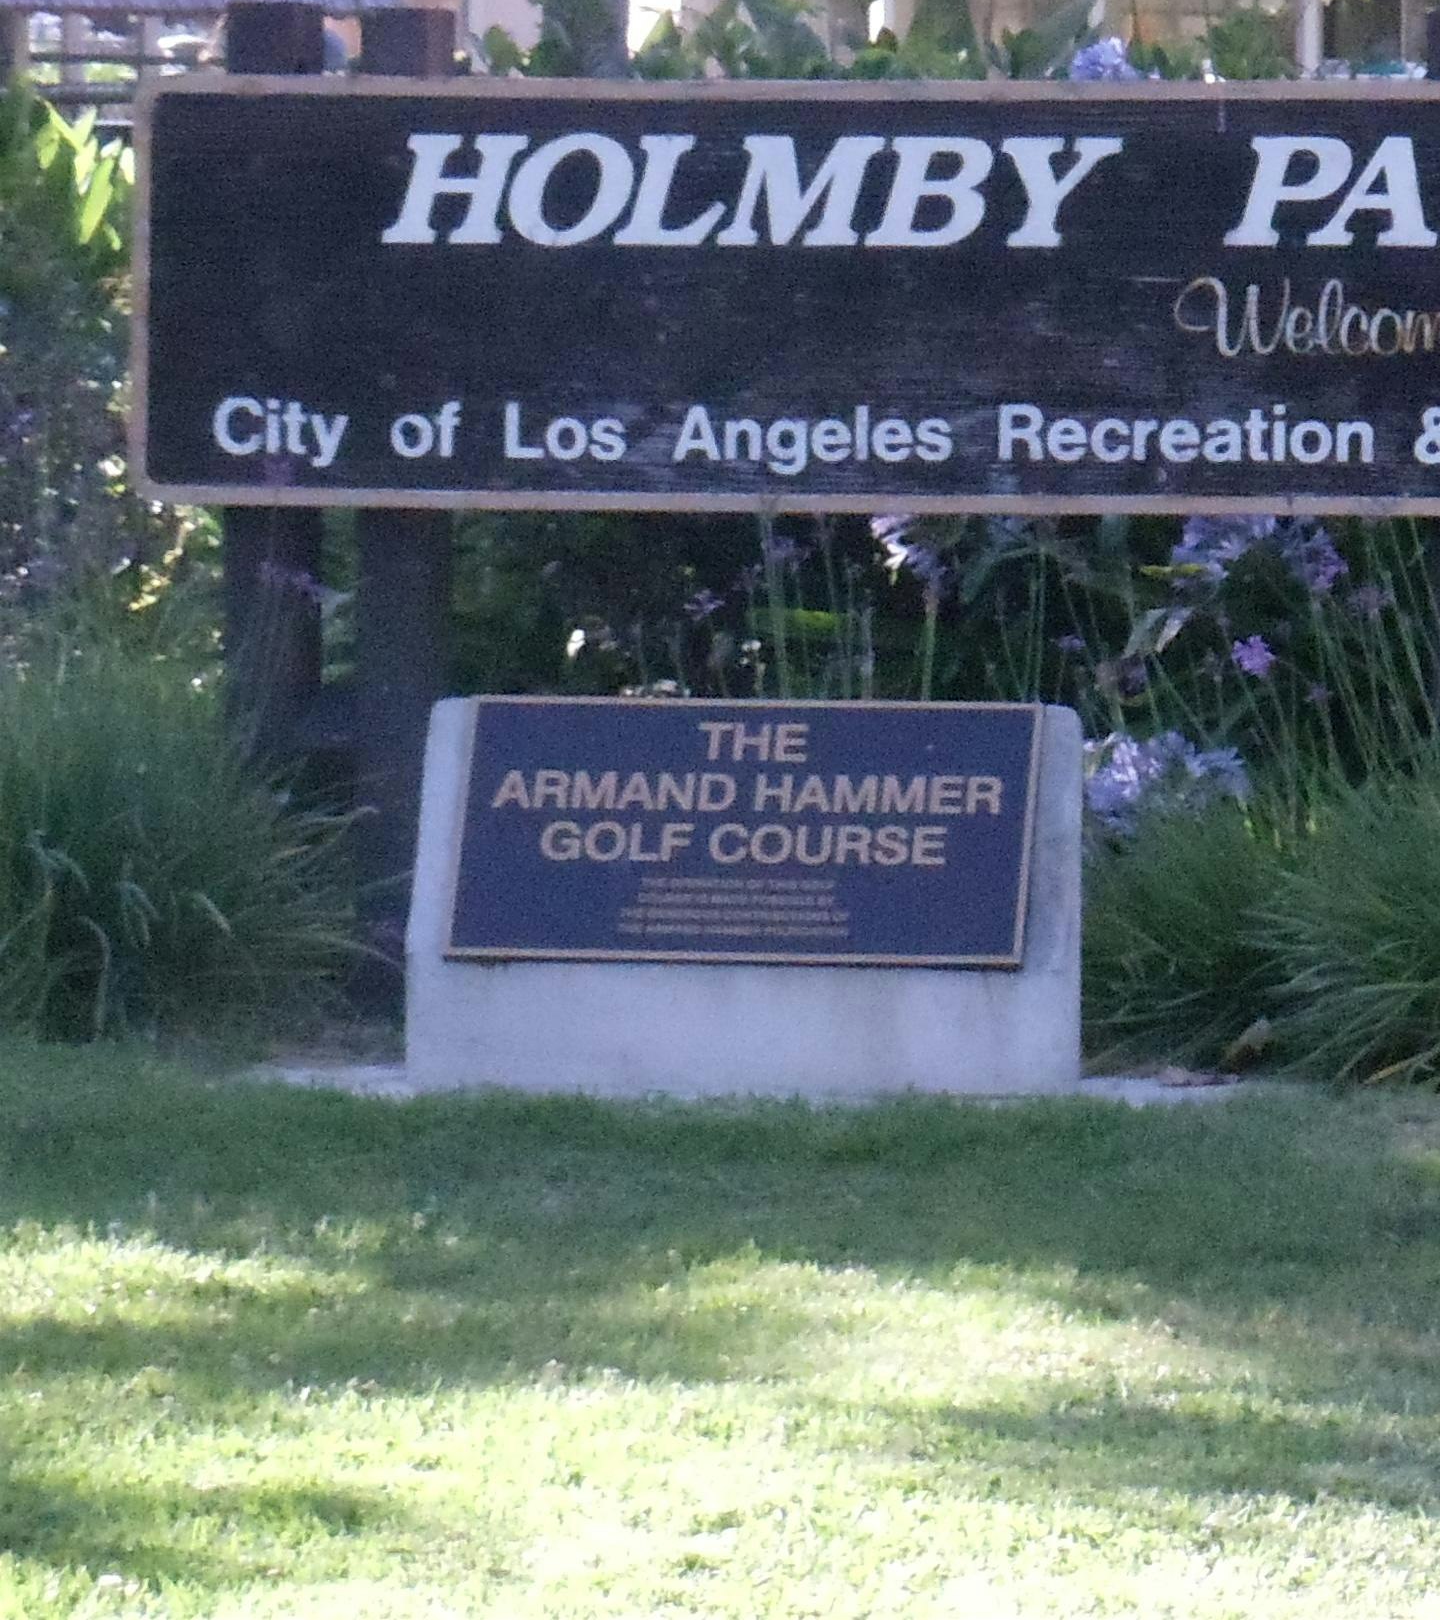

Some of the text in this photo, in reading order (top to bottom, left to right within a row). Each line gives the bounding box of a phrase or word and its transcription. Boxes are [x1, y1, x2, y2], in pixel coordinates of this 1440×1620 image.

[382, 132, 1122, 248] HOLMBY
[213, 397, 348, 468] City
[390, 400, 459, 459] of
[504, 401, 626, 460] Los
[674, 404, 953, 473] Angeles
[999, 404, 1375, 464] Recreation
[699, 721, 809, 763] THE
[492, 770, 1001, 814] ARMAND HAMMER
[540, 822, 948, 865] GOLF COURSE
